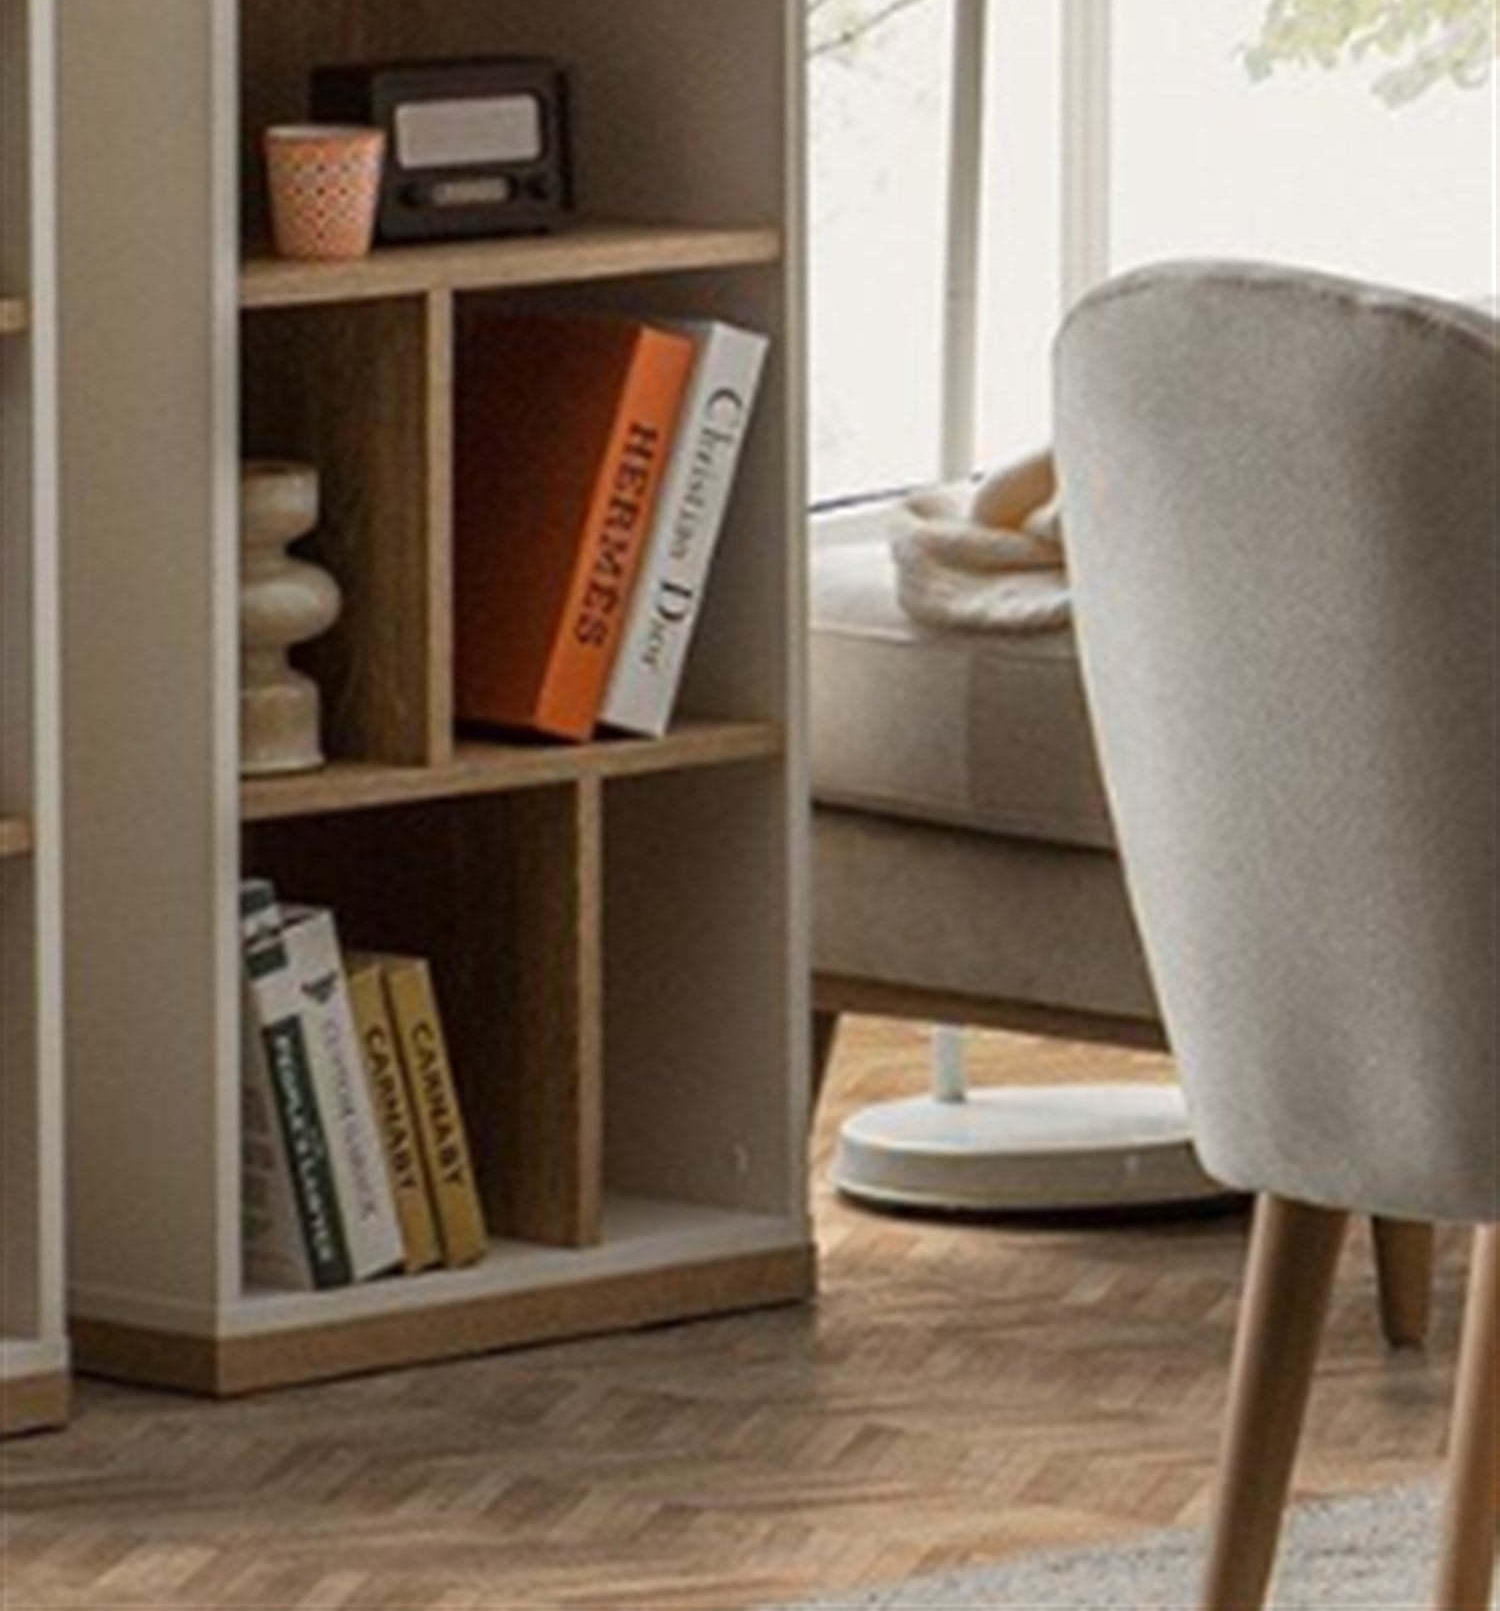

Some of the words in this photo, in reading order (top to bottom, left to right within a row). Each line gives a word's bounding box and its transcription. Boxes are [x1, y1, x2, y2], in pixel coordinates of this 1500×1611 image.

[572, 421, 660, 650] HERMES
[662, 388, 744, 561] Christian
[640, 579, 695, 672] Dior
[365, 1024, 419, 1191] CARNABY
[410, 1021, 469, 1187] CARNABY
